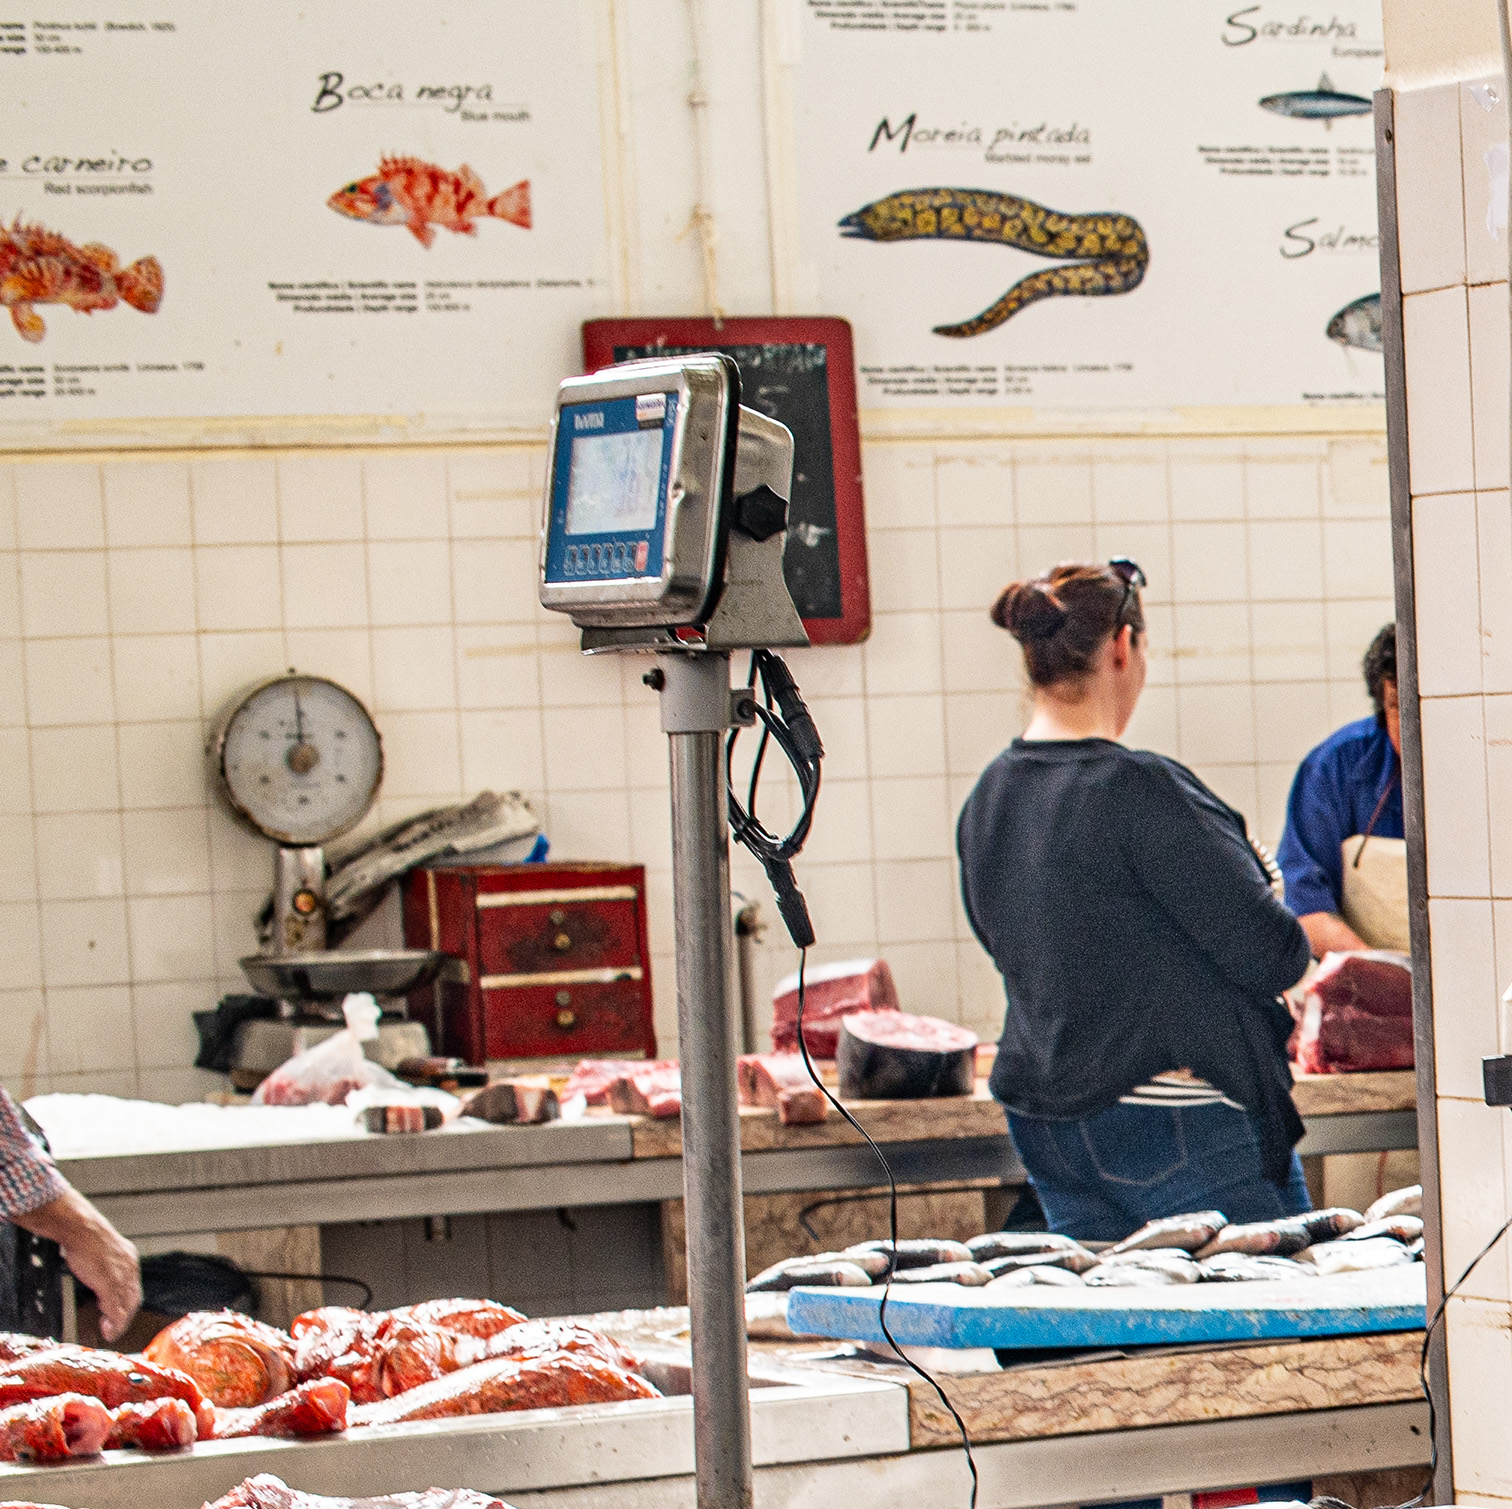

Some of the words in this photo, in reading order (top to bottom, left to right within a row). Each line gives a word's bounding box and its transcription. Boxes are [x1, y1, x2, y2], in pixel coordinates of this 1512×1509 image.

[1221, 5, 1357, 47] Sardinha
[310, 71, 403, 113] Boca
[415, 82, 493, 113] negra
[868, 112, 982, 153] Moreia
[985, 121, 1091, 154] pintada
[21, 148, 153, 174] carneiro
